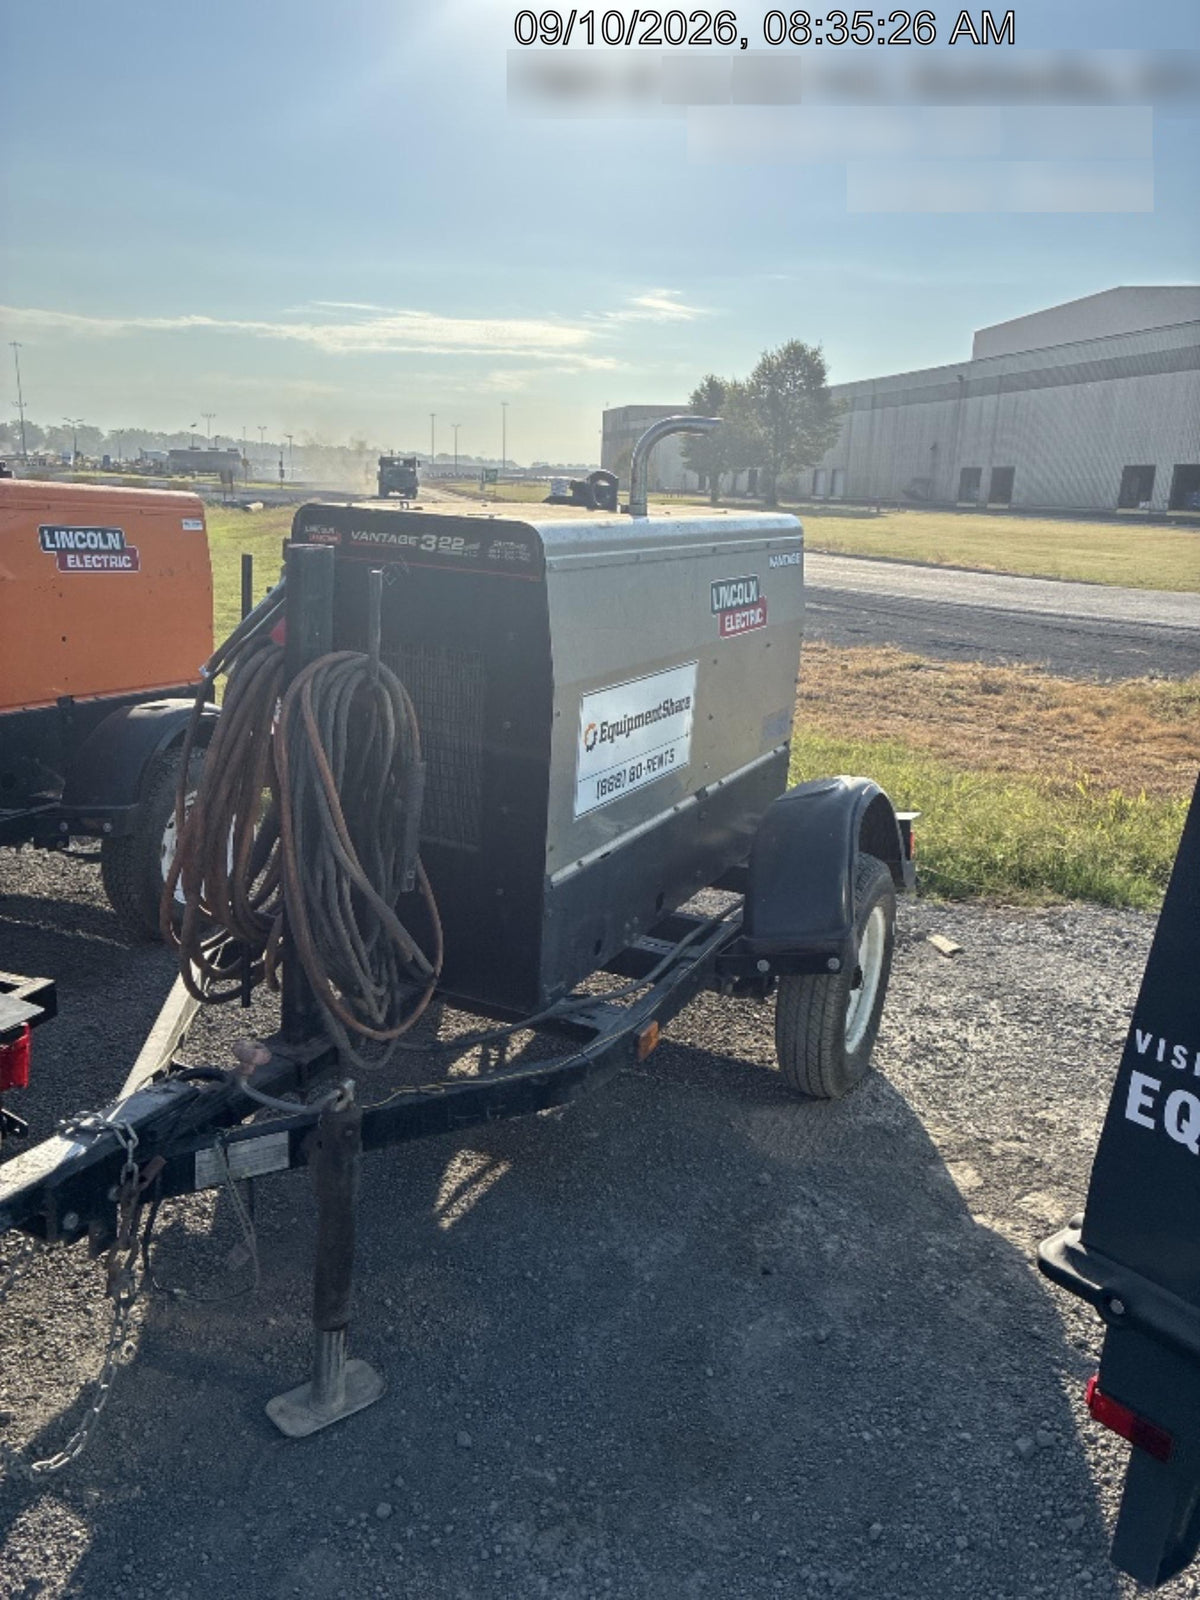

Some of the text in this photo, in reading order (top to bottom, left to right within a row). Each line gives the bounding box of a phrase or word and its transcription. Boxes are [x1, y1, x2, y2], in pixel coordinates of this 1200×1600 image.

[43, 530, 121, 550] LINCOLN
[351, 530, 419, 547] VANTAGE
[420, 534, 465, 551] 322
[66, 554, 132, 568] ELECTRIC
[712, 580, 758, 611] LINCOLN
[724, 607, 764, 632] ELECTRIC
[598, 695, 691, 744] EquipmentShare
[596, 769, 627, 801] (888)
[1125, 1069, 1200, 1155] EQ
